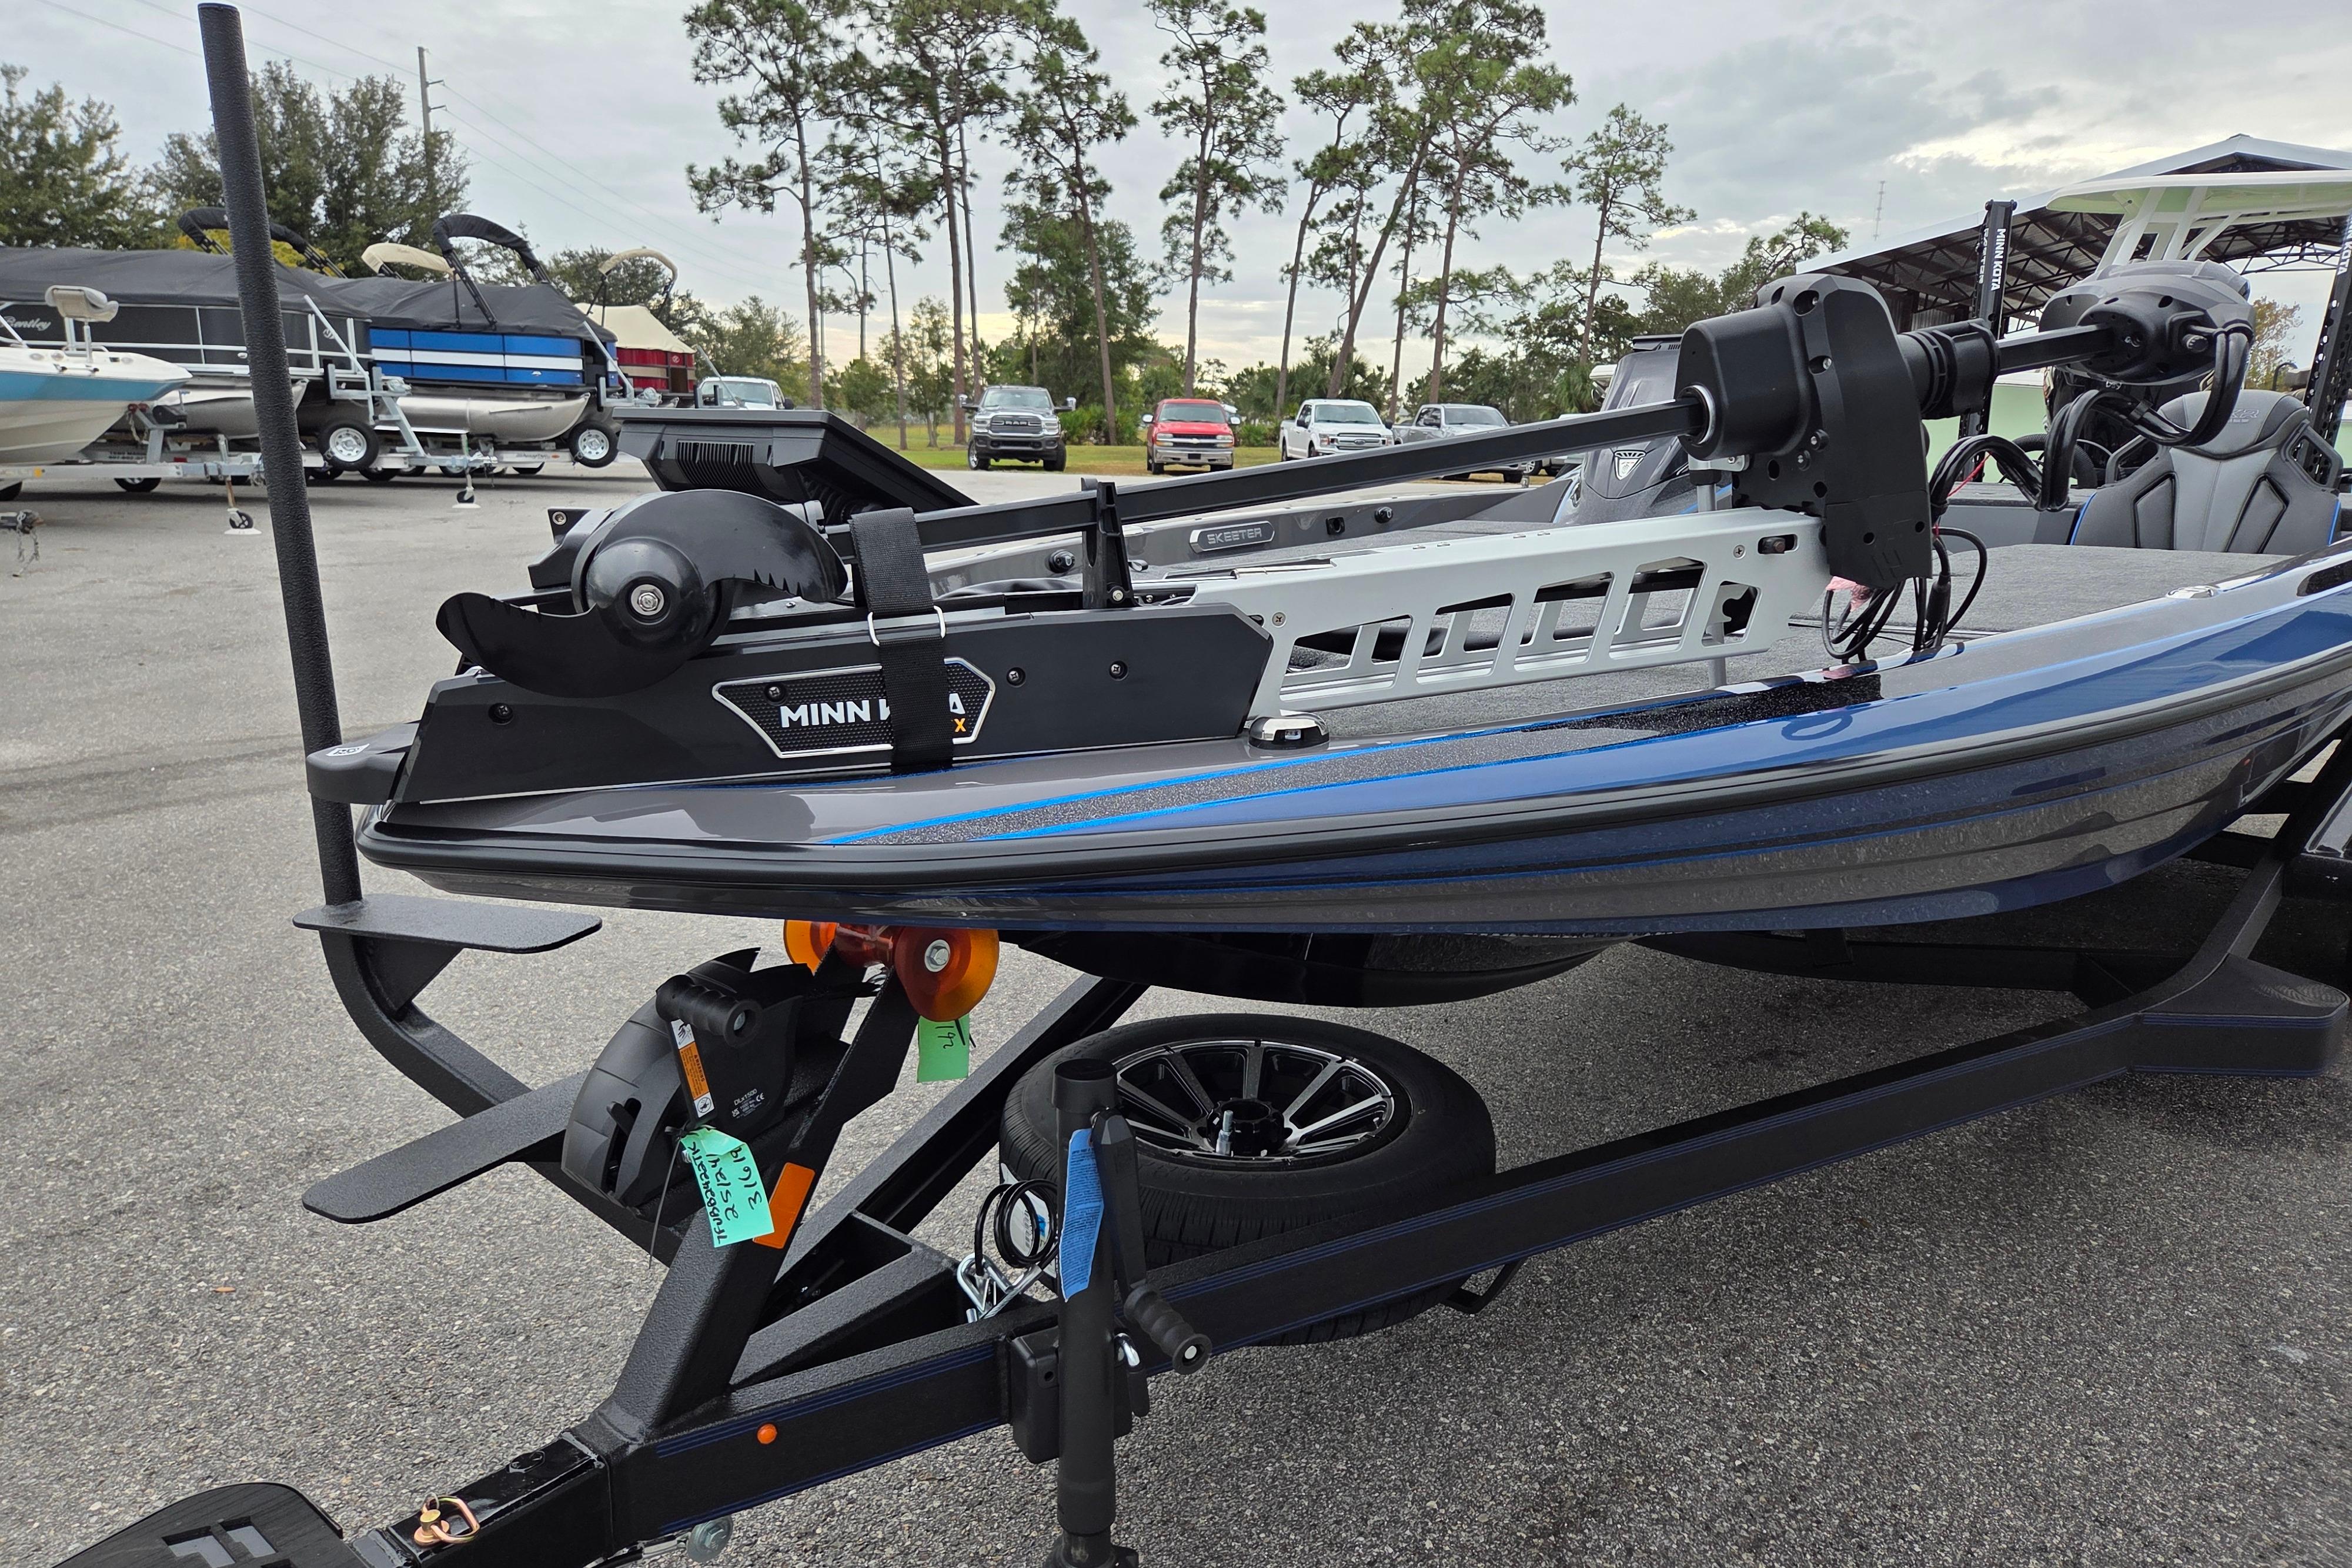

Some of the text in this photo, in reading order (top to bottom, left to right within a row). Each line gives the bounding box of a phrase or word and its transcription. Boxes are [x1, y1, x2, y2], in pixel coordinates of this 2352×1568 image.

[1991, 228, 2006, 291] MINN KOTA
[1207, 527, 1262, 544] SKEETER
[780, 700, 871, 727] MINN
